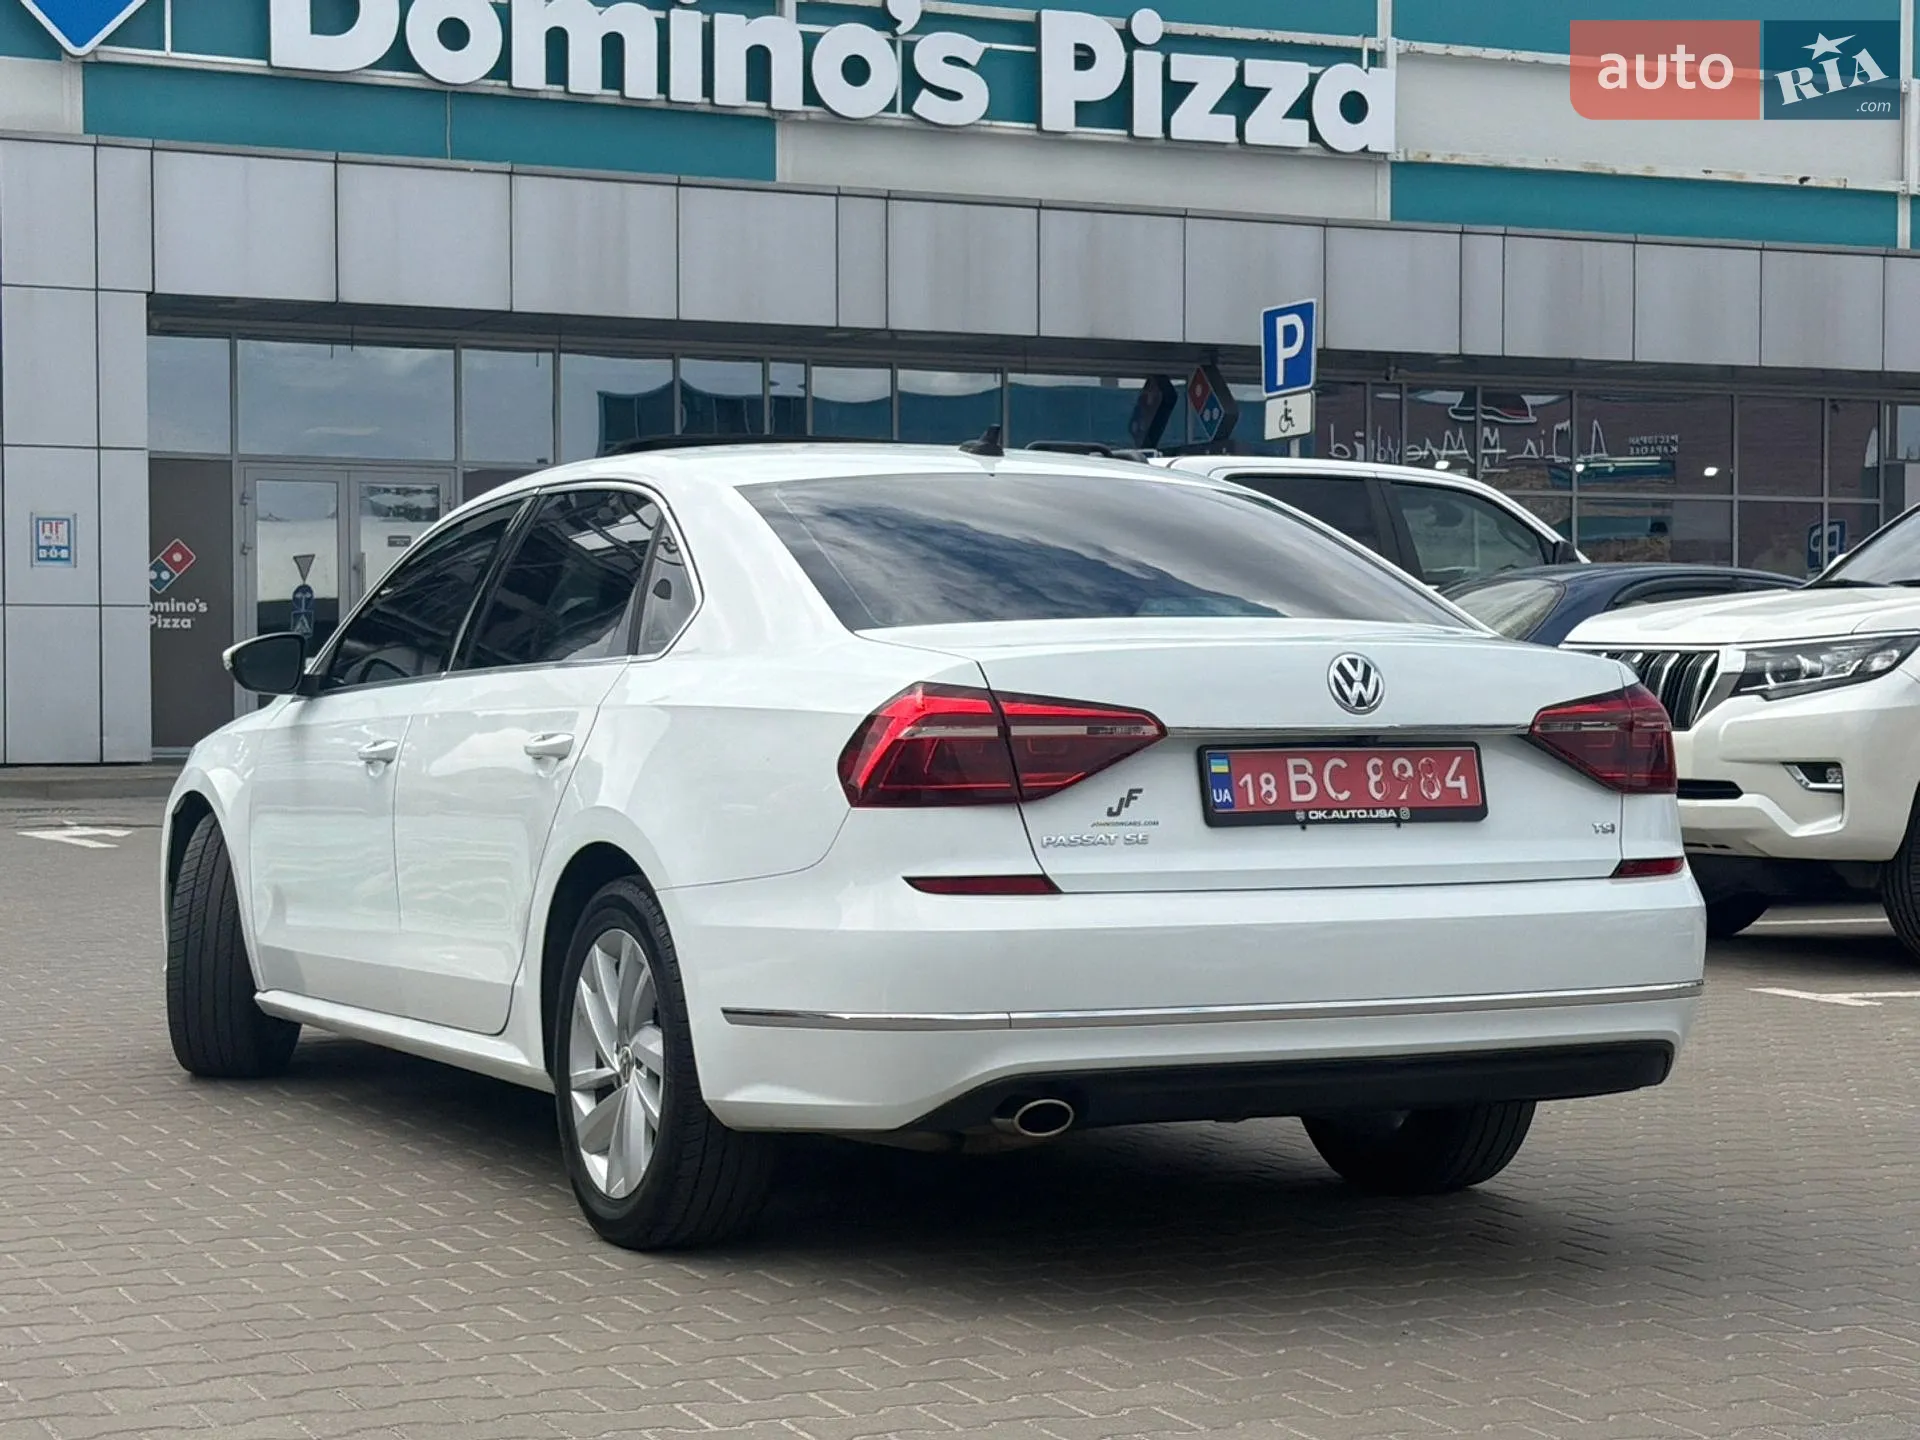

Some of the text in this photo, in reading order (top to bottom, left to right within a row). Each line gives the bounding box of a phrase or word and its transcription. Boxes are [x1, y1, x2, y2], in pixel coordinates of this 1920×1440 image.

[270, 0, 1397, 153] Domino's Pizza
[1276, 313, 1305, 386] P
[150, 597, 208, 612] mino's
[1330, 654, 1383, 711] VW
[1238, 772, 1278, 806] 18
[1286, 757, 1352, 803] BC
[1212, 788, 1233, 805] UA
[1308, 809, 1397, 821] OK.AUTO.USA
[1591, 821, 1616, 835] TSI
[1041, 832, 1149, 848] PASSAT SE
